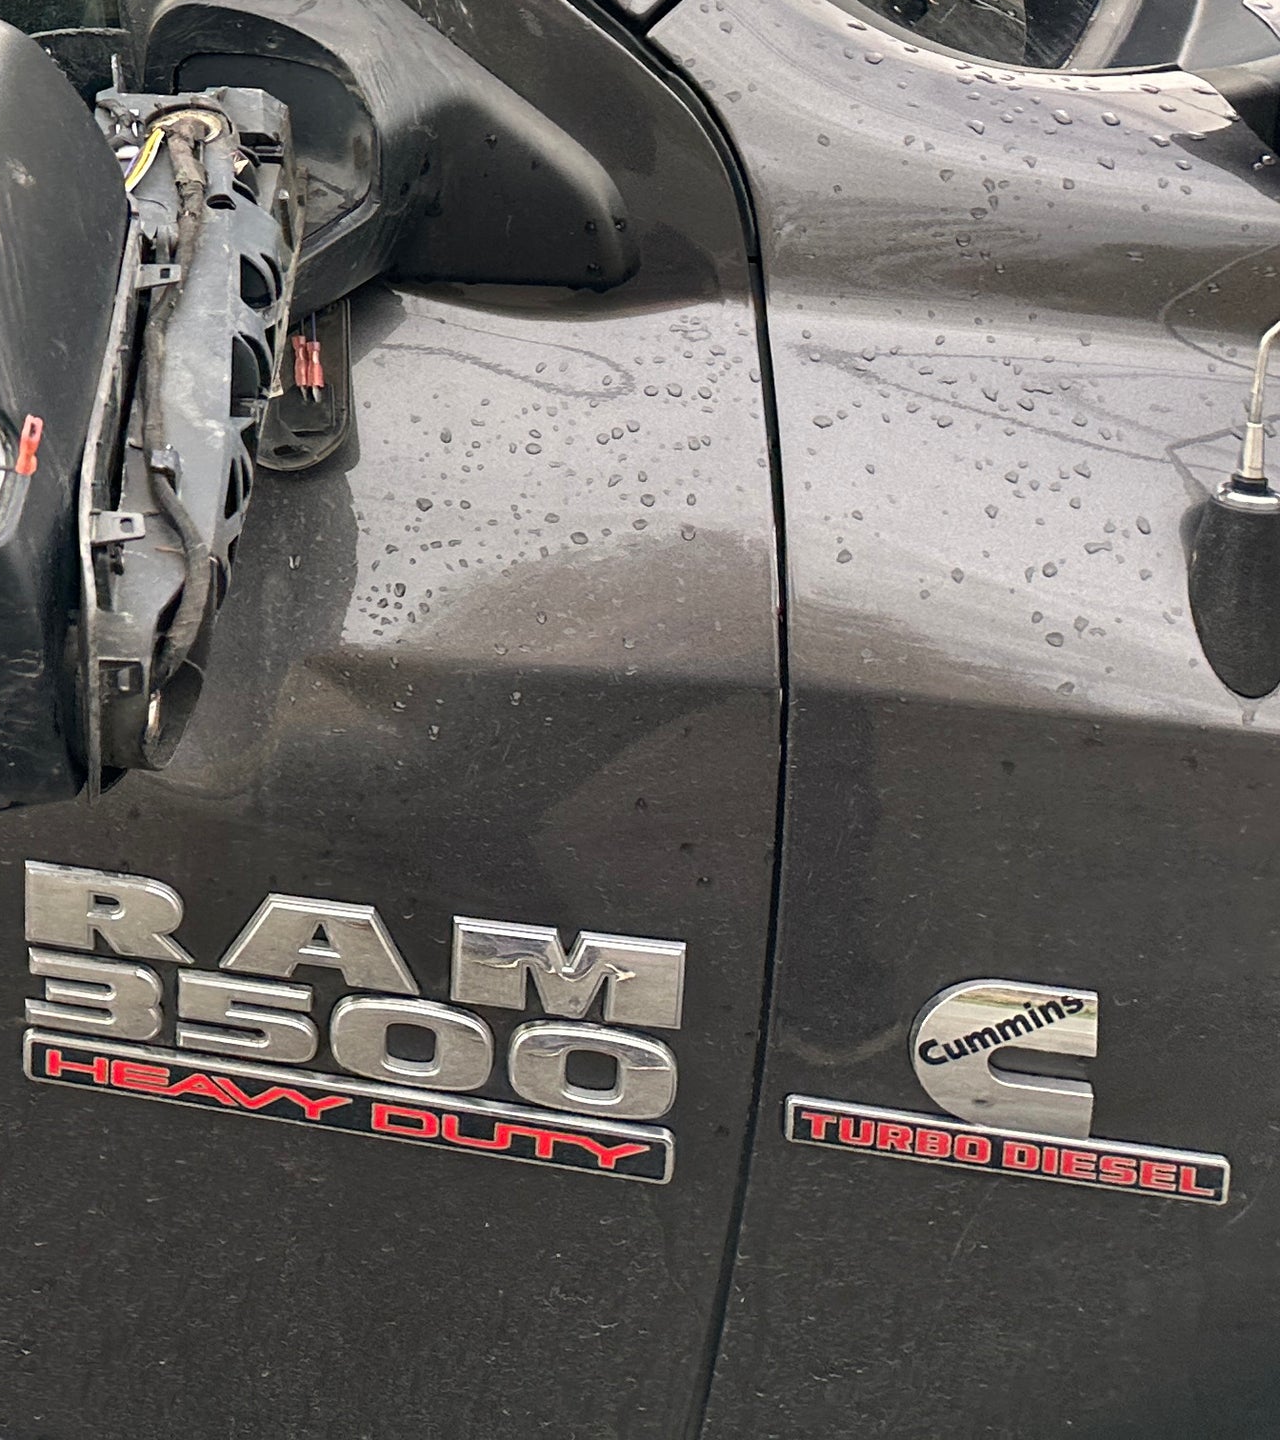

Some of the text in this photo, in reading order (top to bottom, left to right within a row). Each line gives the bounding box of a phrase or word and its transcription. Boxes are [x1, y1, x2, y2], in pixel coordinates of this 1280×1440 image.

[24, 859, 687, 1030] RAM
[24, 945, 678, 1120] 3500
[917, 994, 1086, 1067] Cummins
[44, 1048, 651, 1169] HEAVY DUTY
[801, 1111, 1215, 1198] TURBO DIESEL
